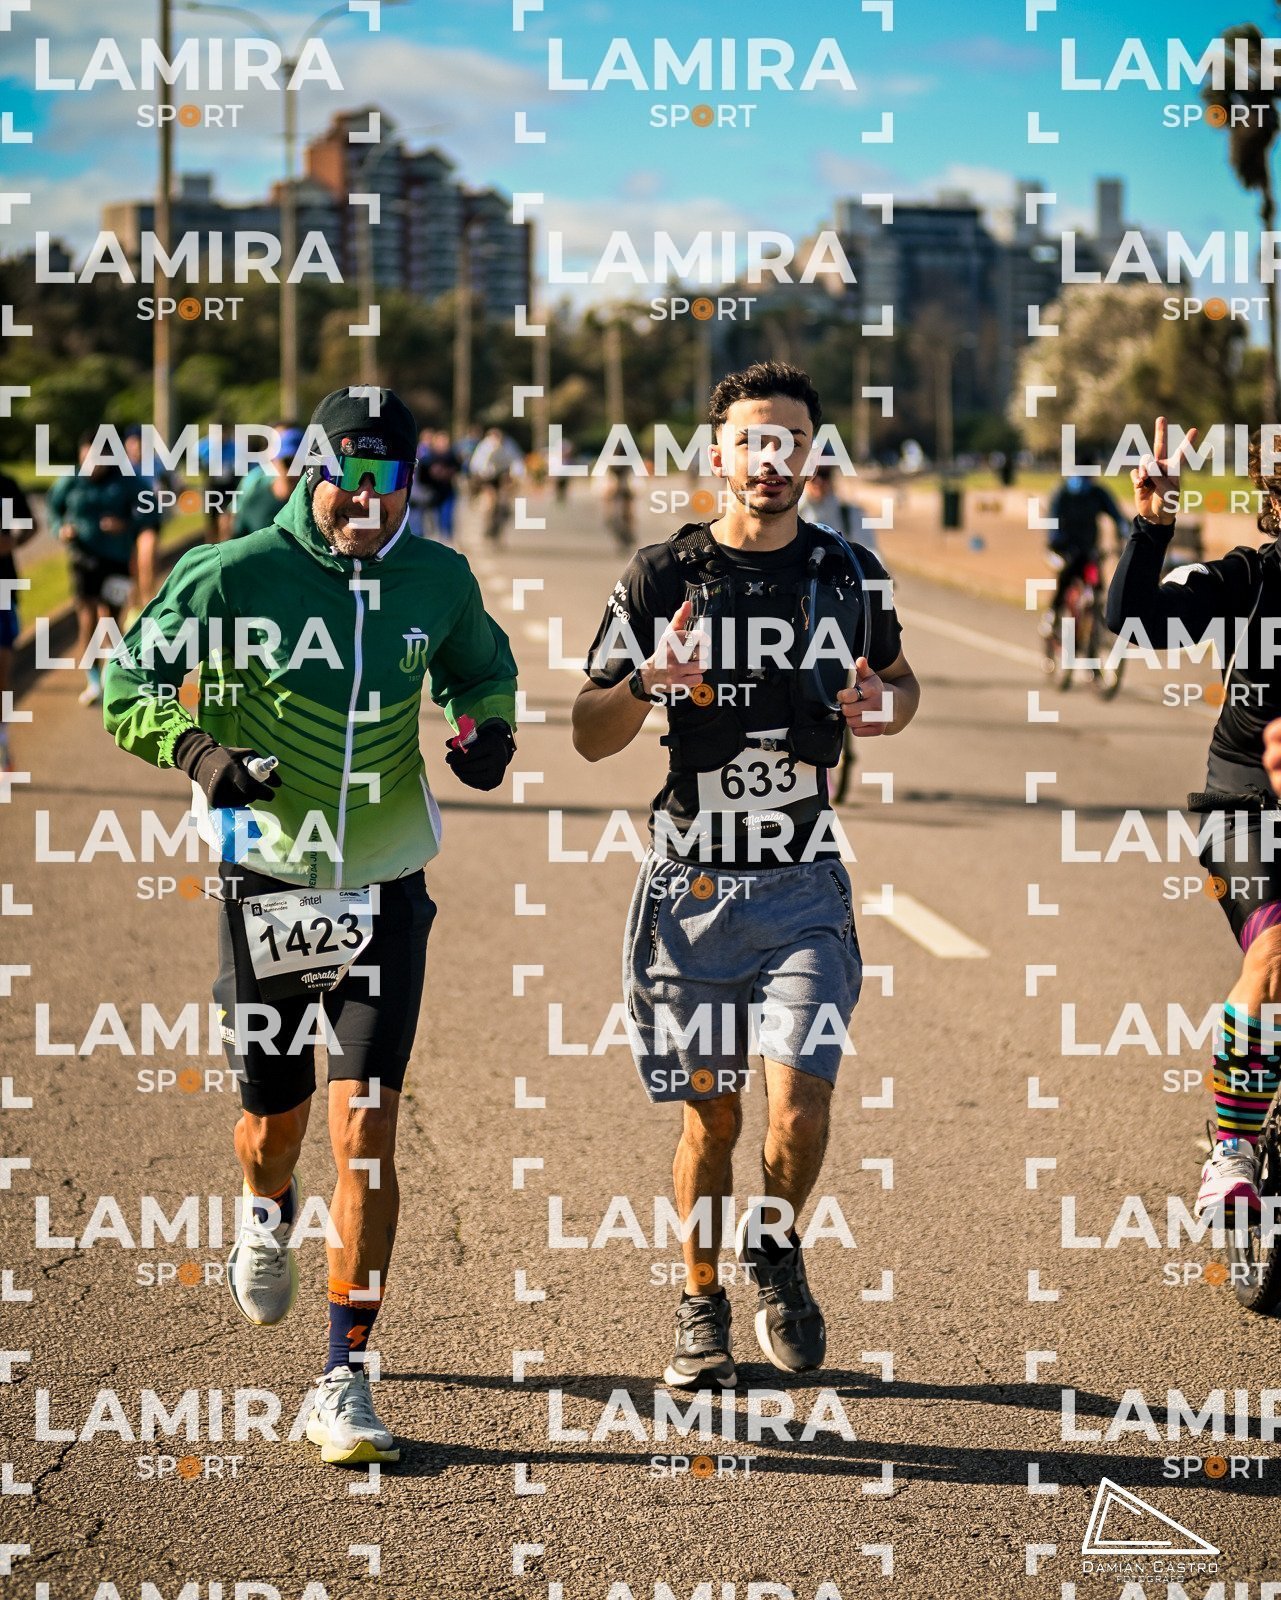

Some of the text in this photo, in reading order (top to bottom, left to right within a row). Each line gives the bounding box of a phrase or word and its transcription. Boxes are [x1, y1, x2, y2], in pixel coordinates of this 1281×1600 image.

[720, 758, 797, 800] 633
[299, 895, 322, 906] antel
[260, 912, 364, 962] 1423
